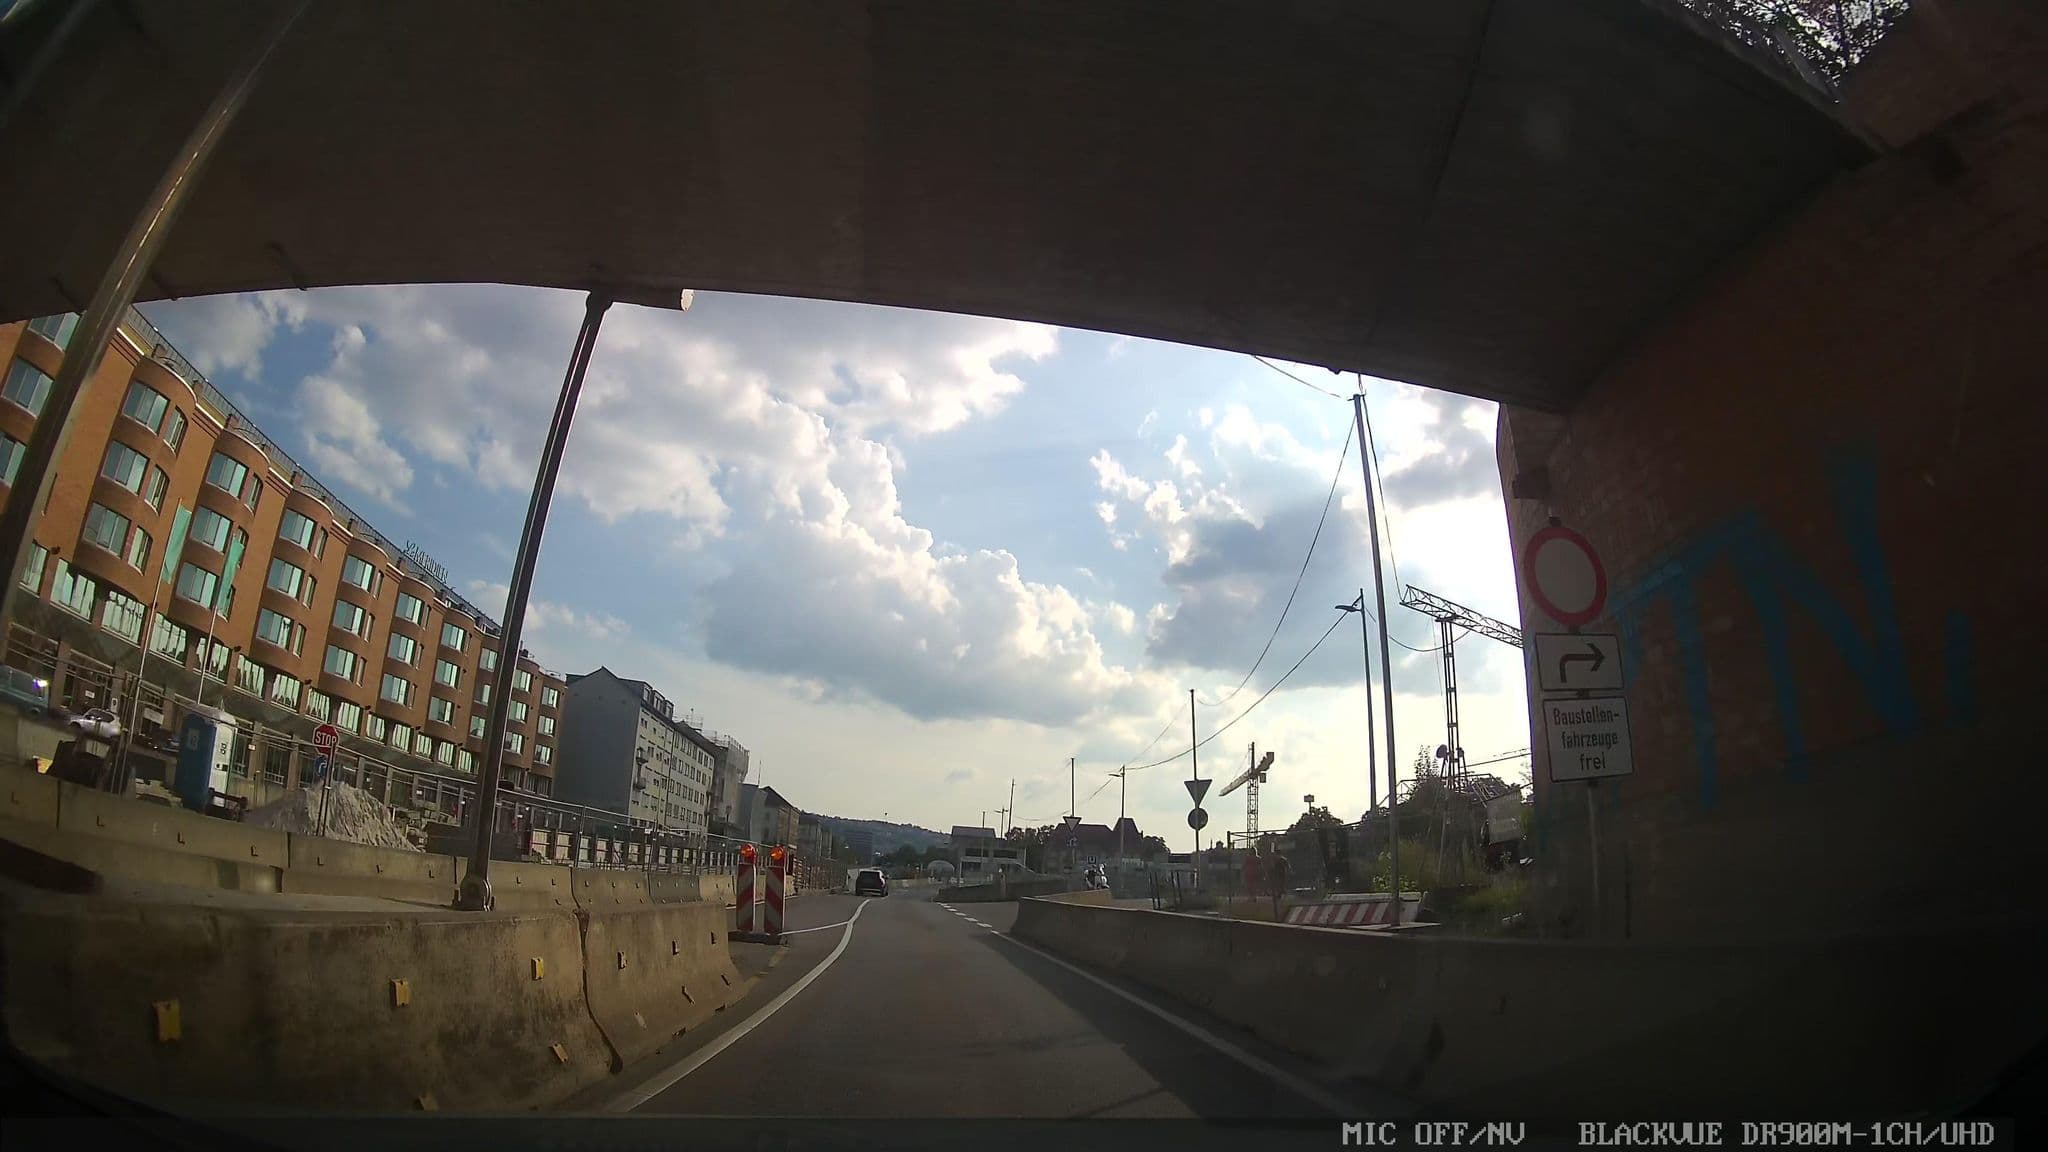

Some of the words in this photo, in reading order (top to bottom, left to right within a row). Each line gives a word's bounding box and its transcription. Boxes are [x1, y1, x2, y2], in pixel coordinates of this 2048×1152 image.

[1553, 705, 1620, 726] Baustellen-
[315, 731, 337, 746] STOP
[1561, 731, 1618, 750] fahrzeuge
[1580, 751, 1606, 771] frei
